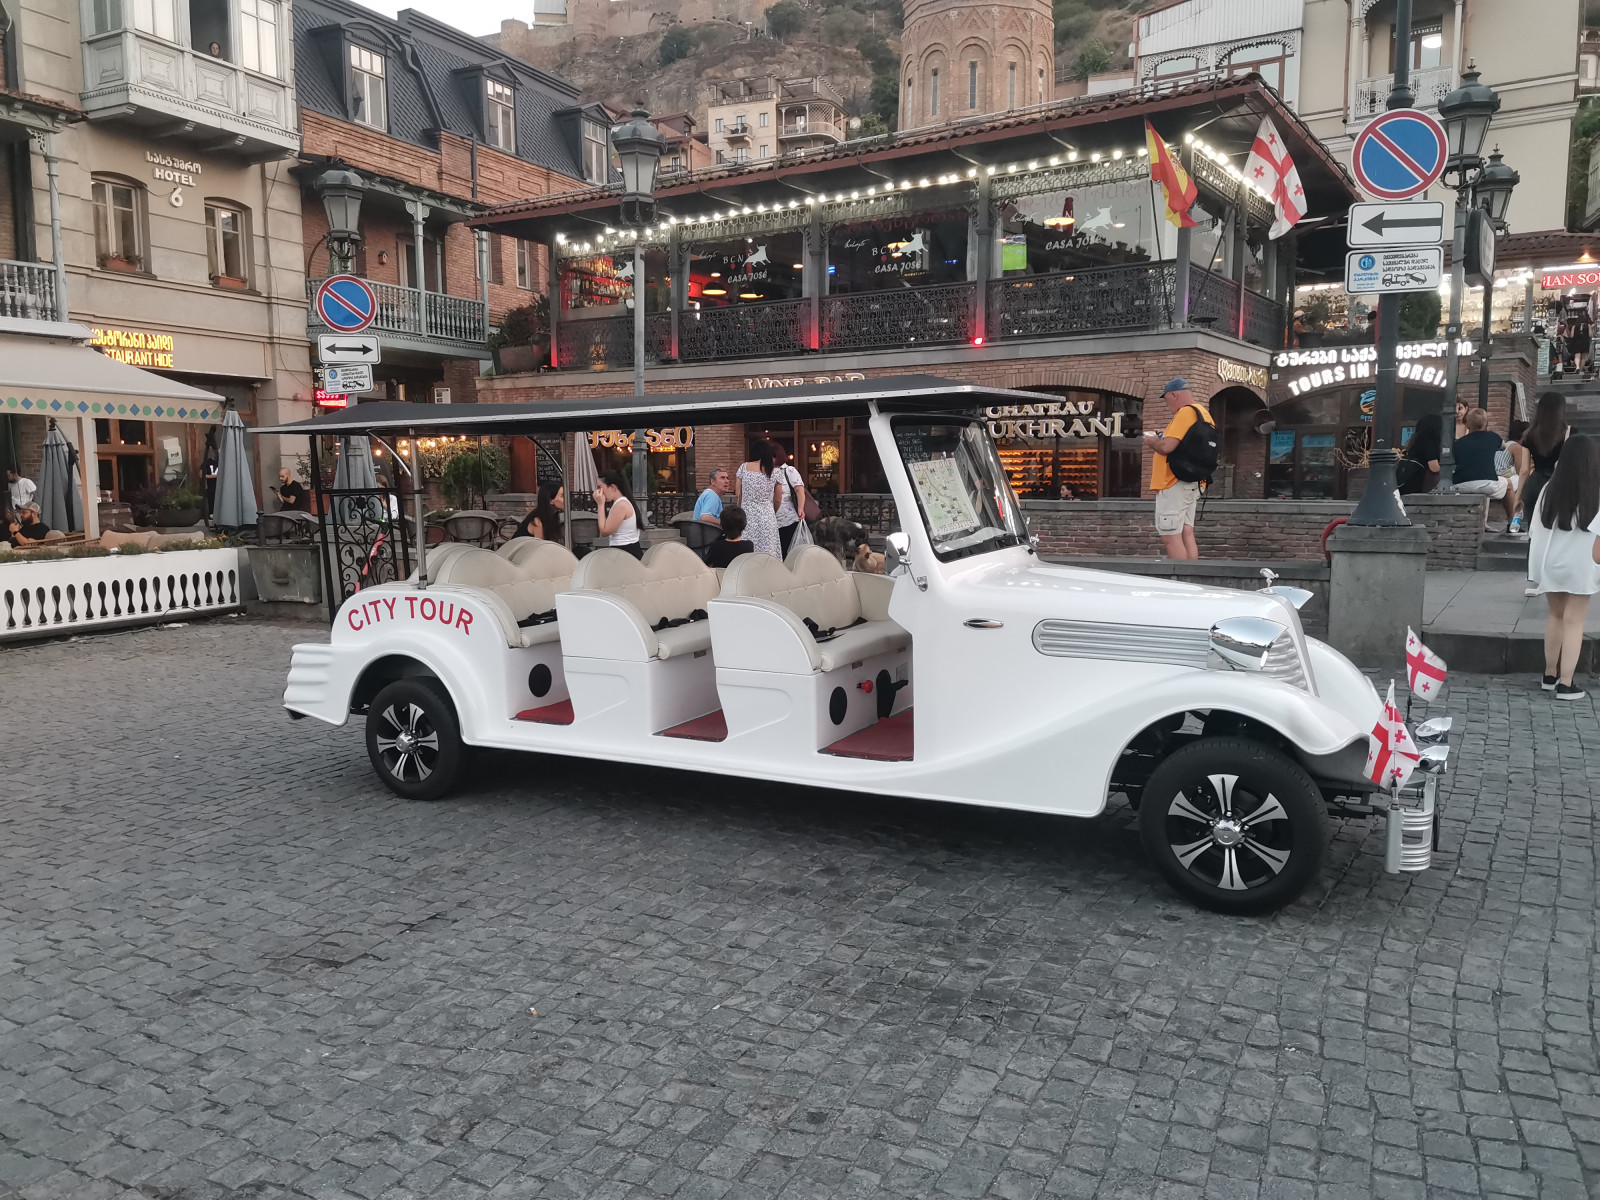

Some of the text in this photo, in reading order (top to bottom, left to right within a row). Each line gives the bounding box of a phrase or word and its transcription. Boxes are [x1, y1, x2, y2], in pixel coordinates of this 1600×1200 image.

[146, 150, 202, 175] სასტუმრო
[155, 167, 197, 187] HOTEL
[171, 187, 184, 207] 6
[1045, 238, 1074, 251] CASA
[723, 254, 744, 264] BCN
[874, 262, 899, 274] CASA
[727, 274, 748, 284] CASA
[1577, 272, 1600, 285] SO
[153, 353, 174, 368] HIDE
[1287, 364, 1346, 396] TOURS
[1349, 362, 1371, 380] IN
[985, 400, 1095, 419] CHATEAU
[980, 412, 1125, 438] UKHRANI
[348, 596, 474, 636] CITY TOUR
